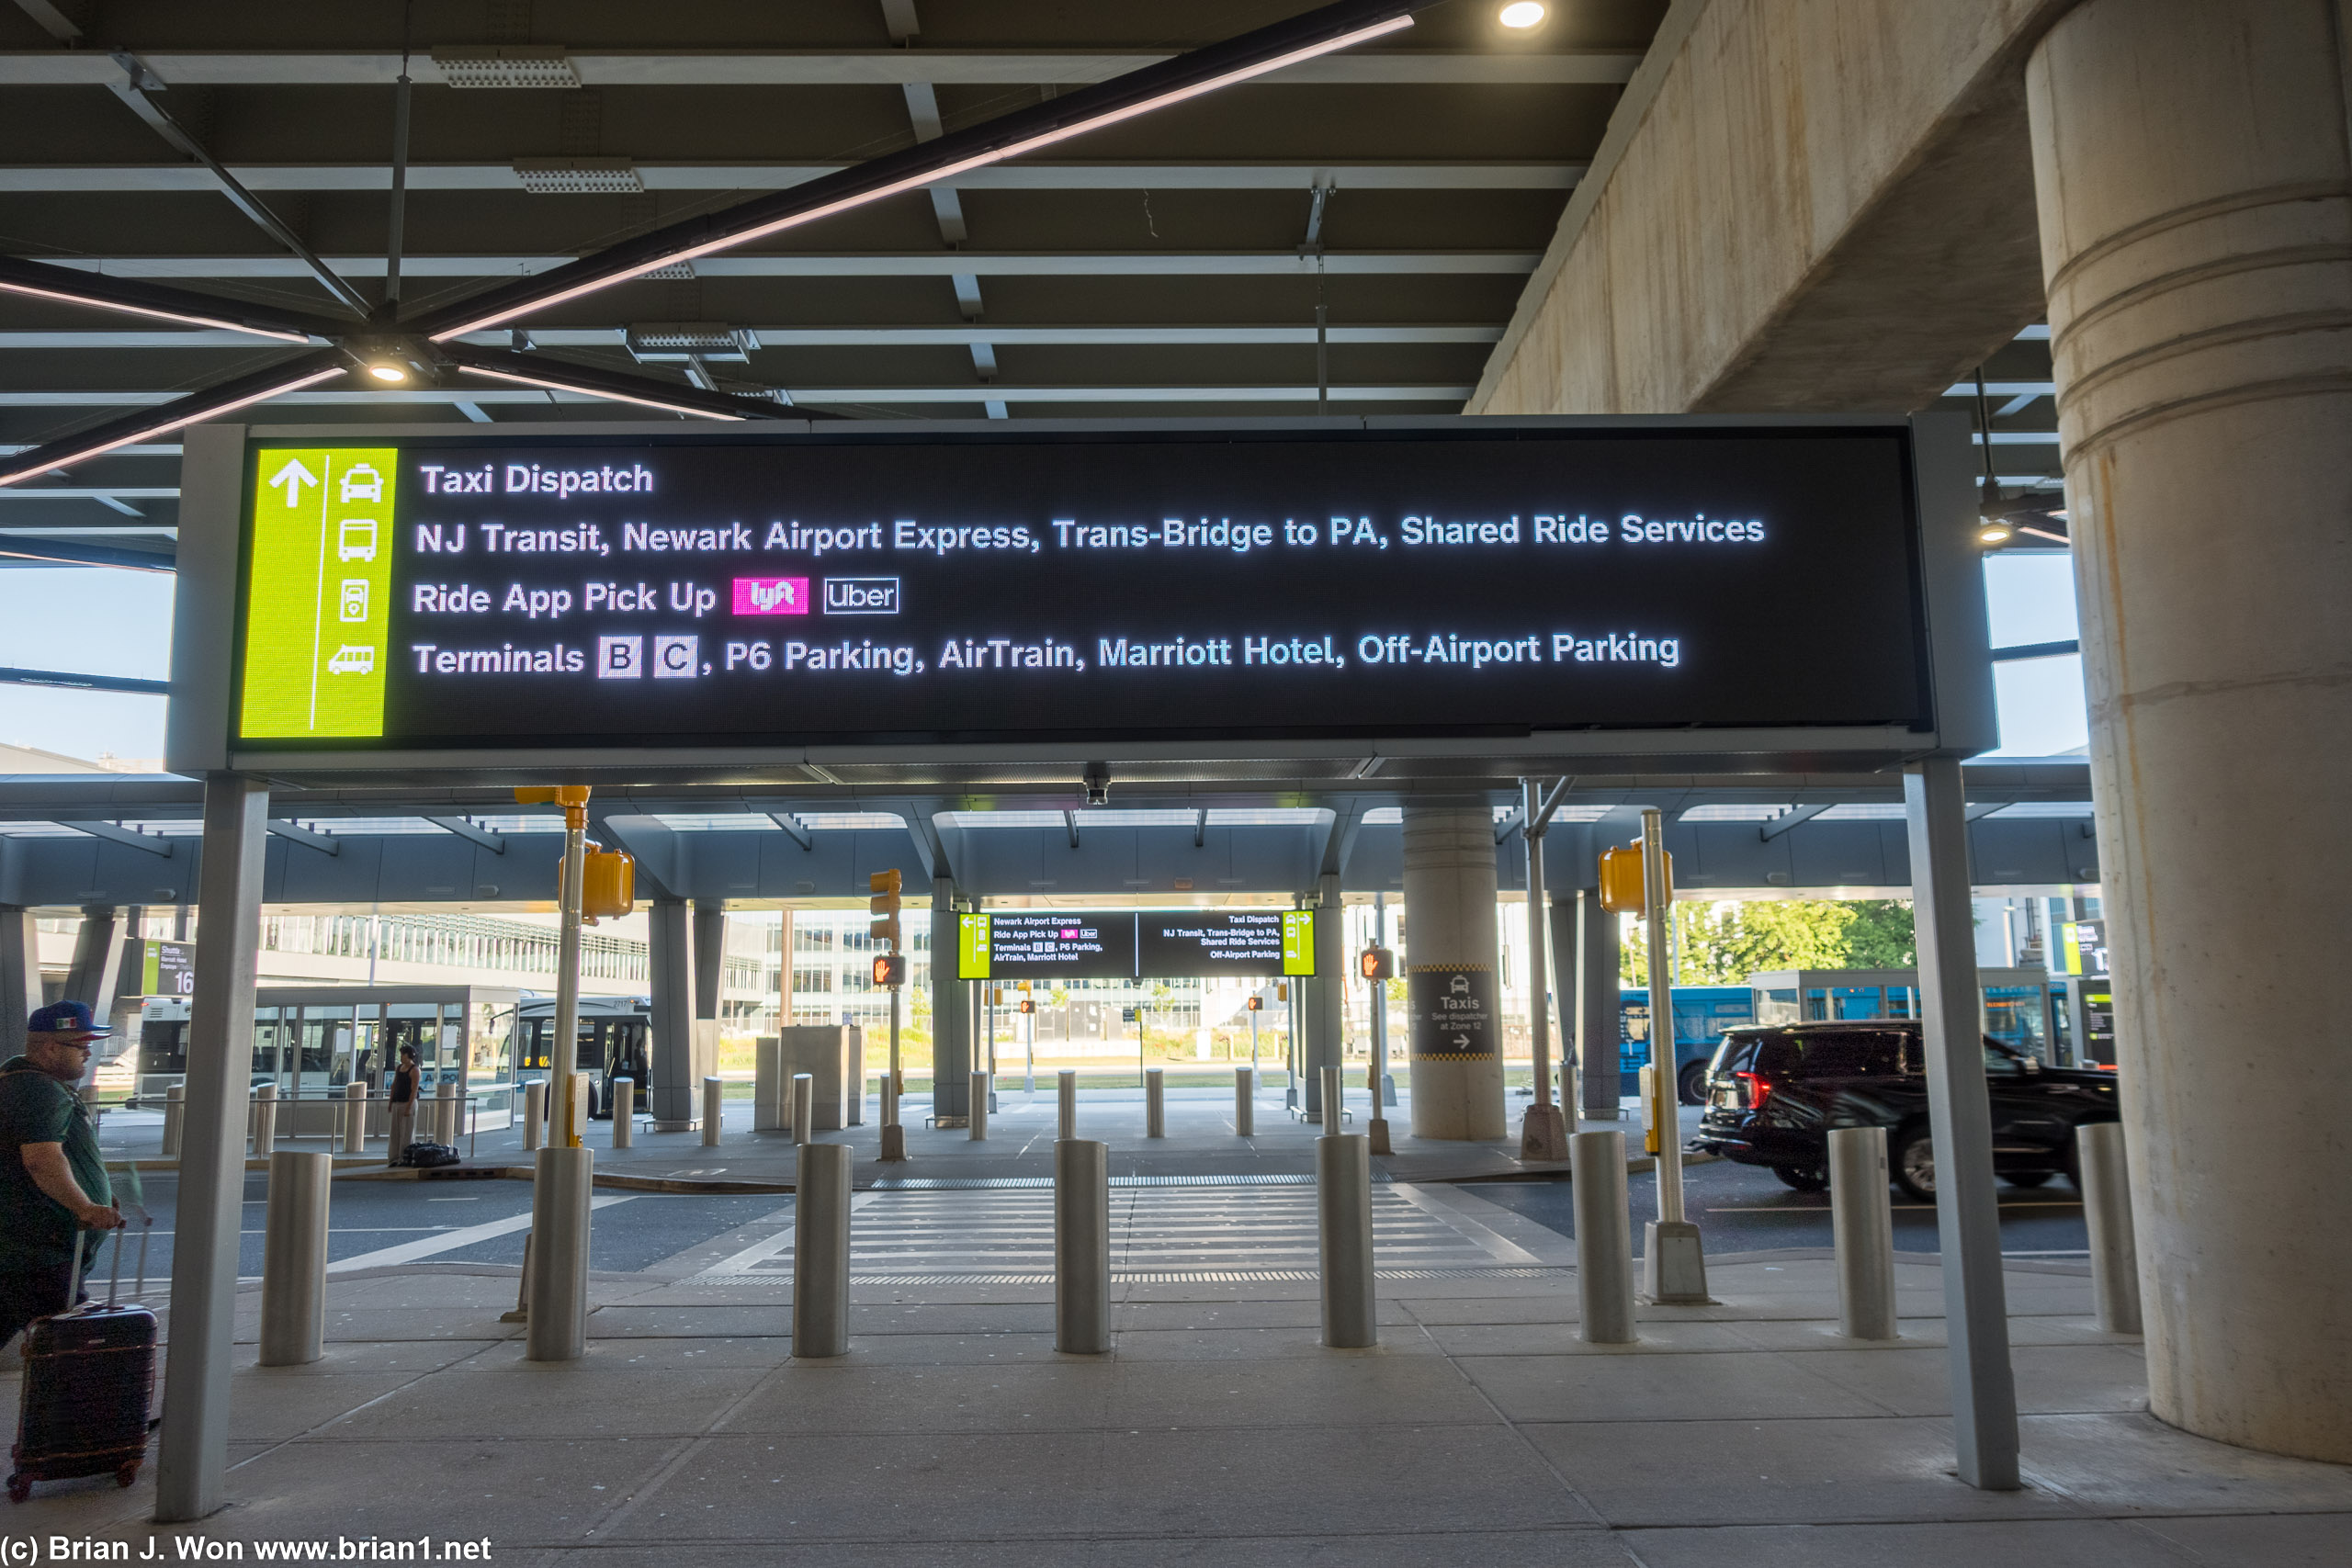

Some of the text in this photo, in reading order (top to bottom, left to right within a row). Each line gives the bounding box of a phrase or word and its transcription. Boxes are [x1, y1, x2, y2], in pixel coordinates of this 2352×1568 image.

[420, 464, 653, 500] Taxi Dispatch
[416, 513, 1765, 557] NJ Transit, Newark Airport Express, Trans-Bridge to PA, Shared Ride Services
[413, 581, 895, 618] Ride App Pick Up lyft Uber
[412, 643, 584, 673] Terminals
[726, 640, 772, 671] P6
[785, 639, 924, 676] Parking,
[938, 638, 1085, 671] AirTrain,
[1099, 637, 1232, 667] Marriott
[1245, 636, 1344, 669] Hotel,
[1358, 634, 1541, 669] Off-Airport
[1553, 634, 1679, 668] Parking
[993, 917, 1081, 927] Newark Airport Express
[1228, 915, 1279, 925] Taxi Dispatch
[993, 931, 1011, 939] Ride
[1012, 931, 1028, 940] App
[1029, 931, 1046, 939] Pick
[1047, 931, 1058, 940] Up
[1162, 929, 1280, 938] NJ Transit, Trans-Bridge to PA,
[1200, 938, 1280, 946] Shared Ride Services
[993, 943, 1031, 952] Terminals
[1059, 943, 1070, 952] P6
[1072, 942, 1103, 953] Parking,
[993, 953, 1079, 962] AirTrain, Marriott Hotel
[1210, 951, 1281, 960] Off-Airport Parking
[175, 971, 194, 993] 16
[1440, 997, 1480, 1010] Taxis
[1431, 1012, 1447, 1021] See
[1449, 1012, 1488, 1021] dispatcher
[1473, 1021, 1482, 1030] 12
